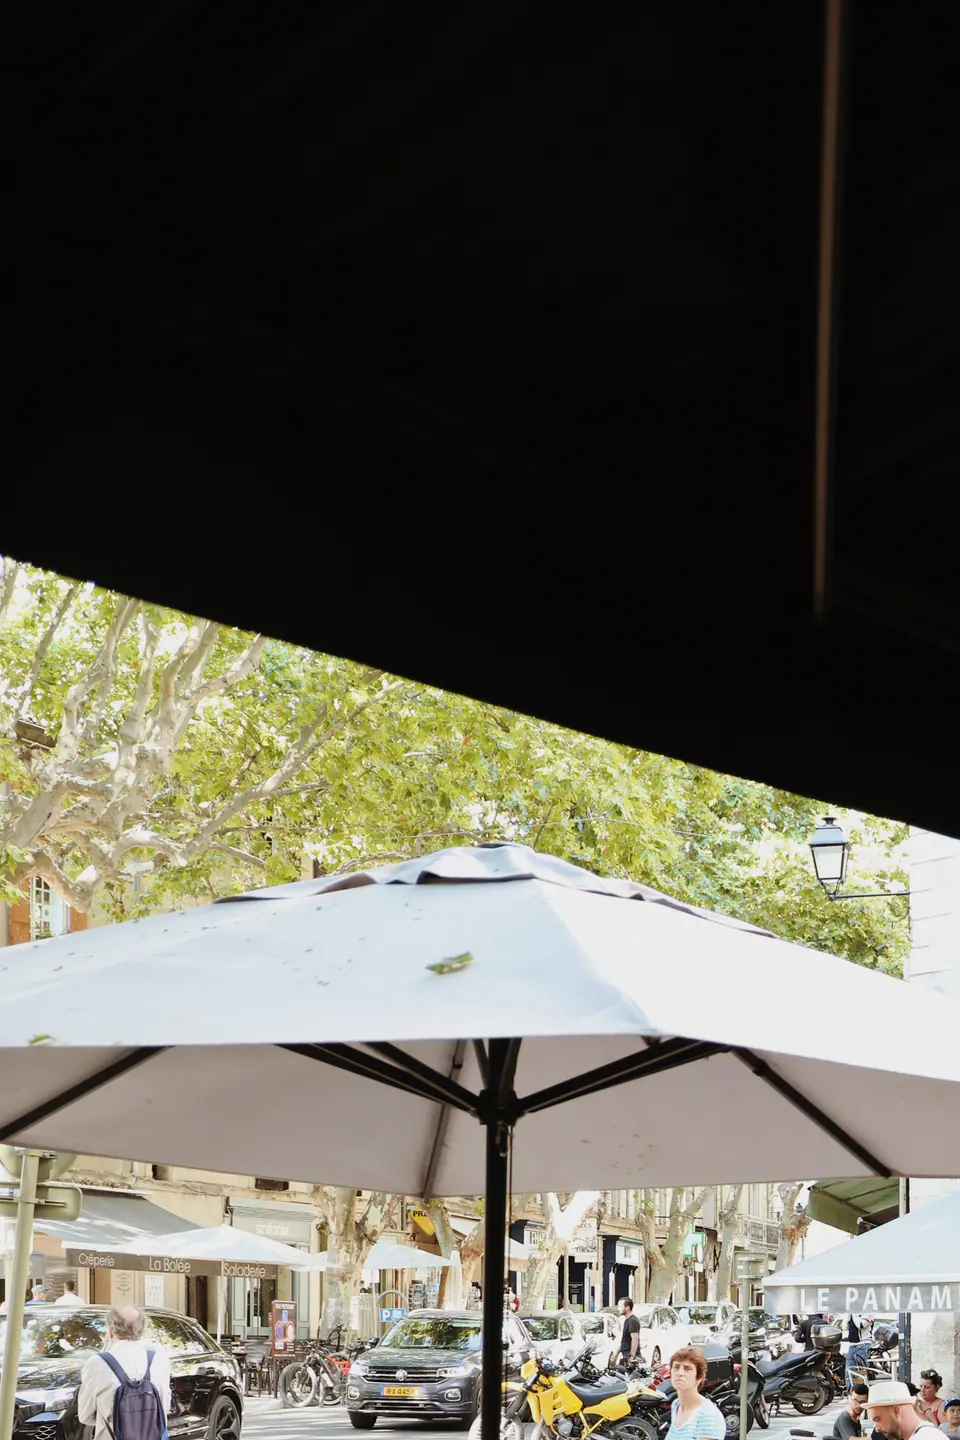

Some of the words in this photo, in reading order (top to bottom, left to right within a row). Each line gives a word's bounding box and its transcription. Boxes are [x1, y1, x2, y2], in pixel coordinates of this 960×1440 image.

[254, 1221, 289, 1236] sinfonia
[78, 1252, 115, 1268] Crêperie
[149, 1257, 161, 1271] La
[163, 1257, 191, 1273] Bolée
[223, 1262, 266, 1278] Saladerie
[800, 1287, 830, 1311] LE
